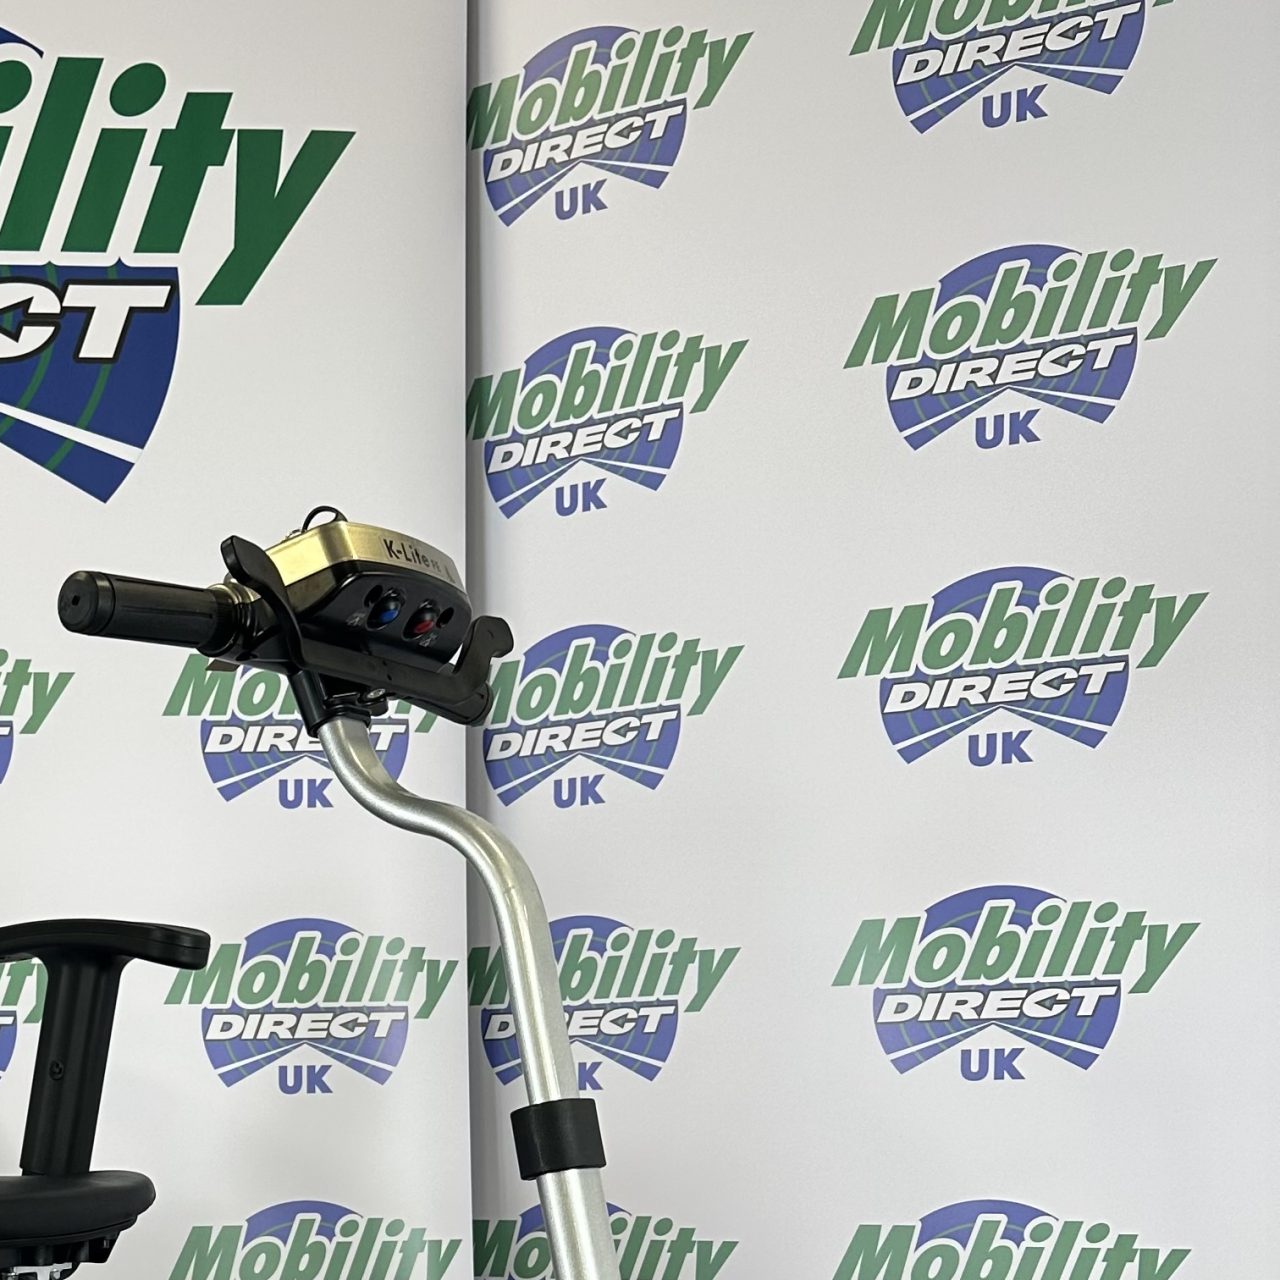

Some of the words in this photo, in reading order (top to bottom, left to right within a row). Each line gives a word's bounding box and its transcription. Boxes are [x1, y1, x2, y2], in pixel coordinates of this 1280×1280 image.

[896, 2, 1141, 85] DIRECT
[467, 26, 751, 149] Mobility
[982, 83, 1048, 128] UK
[486, 104, 685, 182] DIRECT
[555, 179, 608, 220] UK
[843, 249, 1218, 369] Mobility
[467, 330, 749, 440] Mobility
[890, 334, 1134, 401] DIRECT
[487, 409, 680, 474] DIRECT
[975, 408, 1041, 449] UK
[556, 478, 607, 516] UK
[383, 539, 431, 568] K-Lite
[837, 577, 1210, 679] Mobility
[883, 662, 1126, 713] DIRECT
[204, 724, 407, 753] DIRET
[486, 711, 678, 761] DIRECT
[968, 730, 1033, 767] UK
[278, 779, 334, 809] UK
[554, 774, 606, 808] UK
[831, 901, 1201, 994] Mobility
[164, 936, 459, 1019] Mobility
[468, 929, 741, 1012] Mbility
[205, 1012, 405, 1040] DIRECT
[484, 1006, 675, 1039] DECT
[876, 986, 1118, 1023] DIRECT
[278, 1065, 333, 1095] UK
[960, 1048, 1025, 1081] UK
